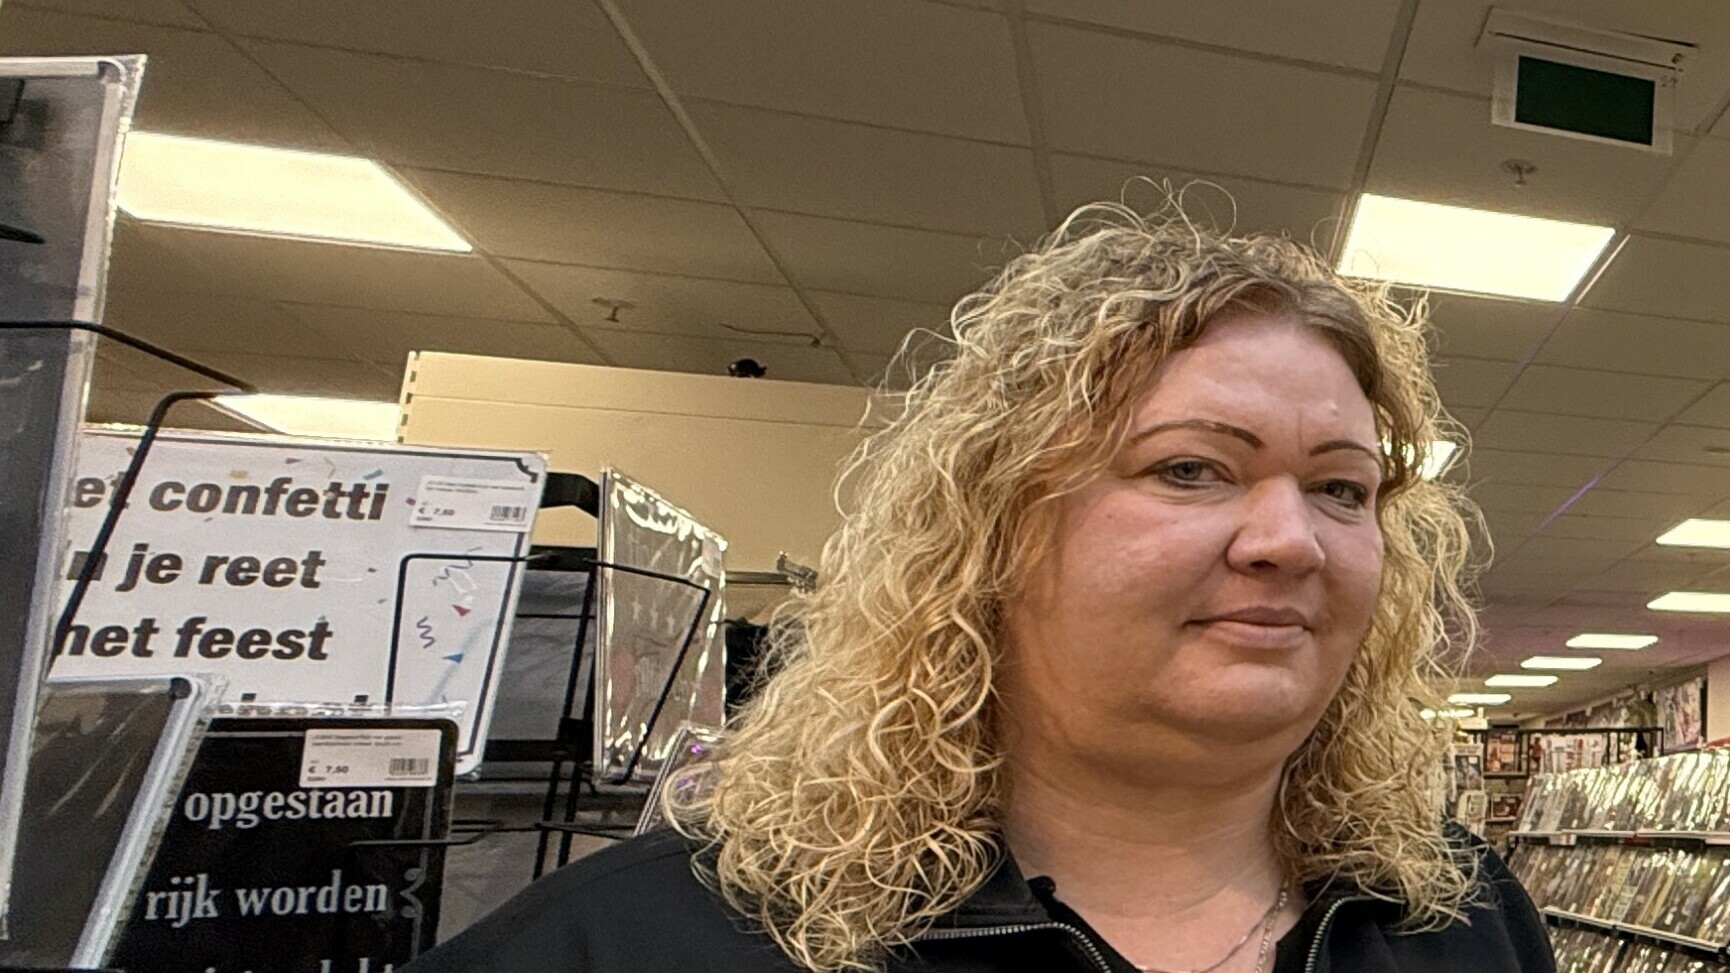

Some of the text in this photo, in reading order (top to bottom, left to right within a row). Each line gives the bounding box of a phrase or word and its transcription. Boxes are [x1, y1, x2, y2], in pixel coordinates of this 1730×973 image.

[148, 475, 389, 520] confetti
[115, 543, 190, 592] je
[198, 549, 325, 590] reet
[172, 616, 333, 662] feest
[184, 786, 394, 830] opgestaan
[145, 869, 388, 928] rijk worden
